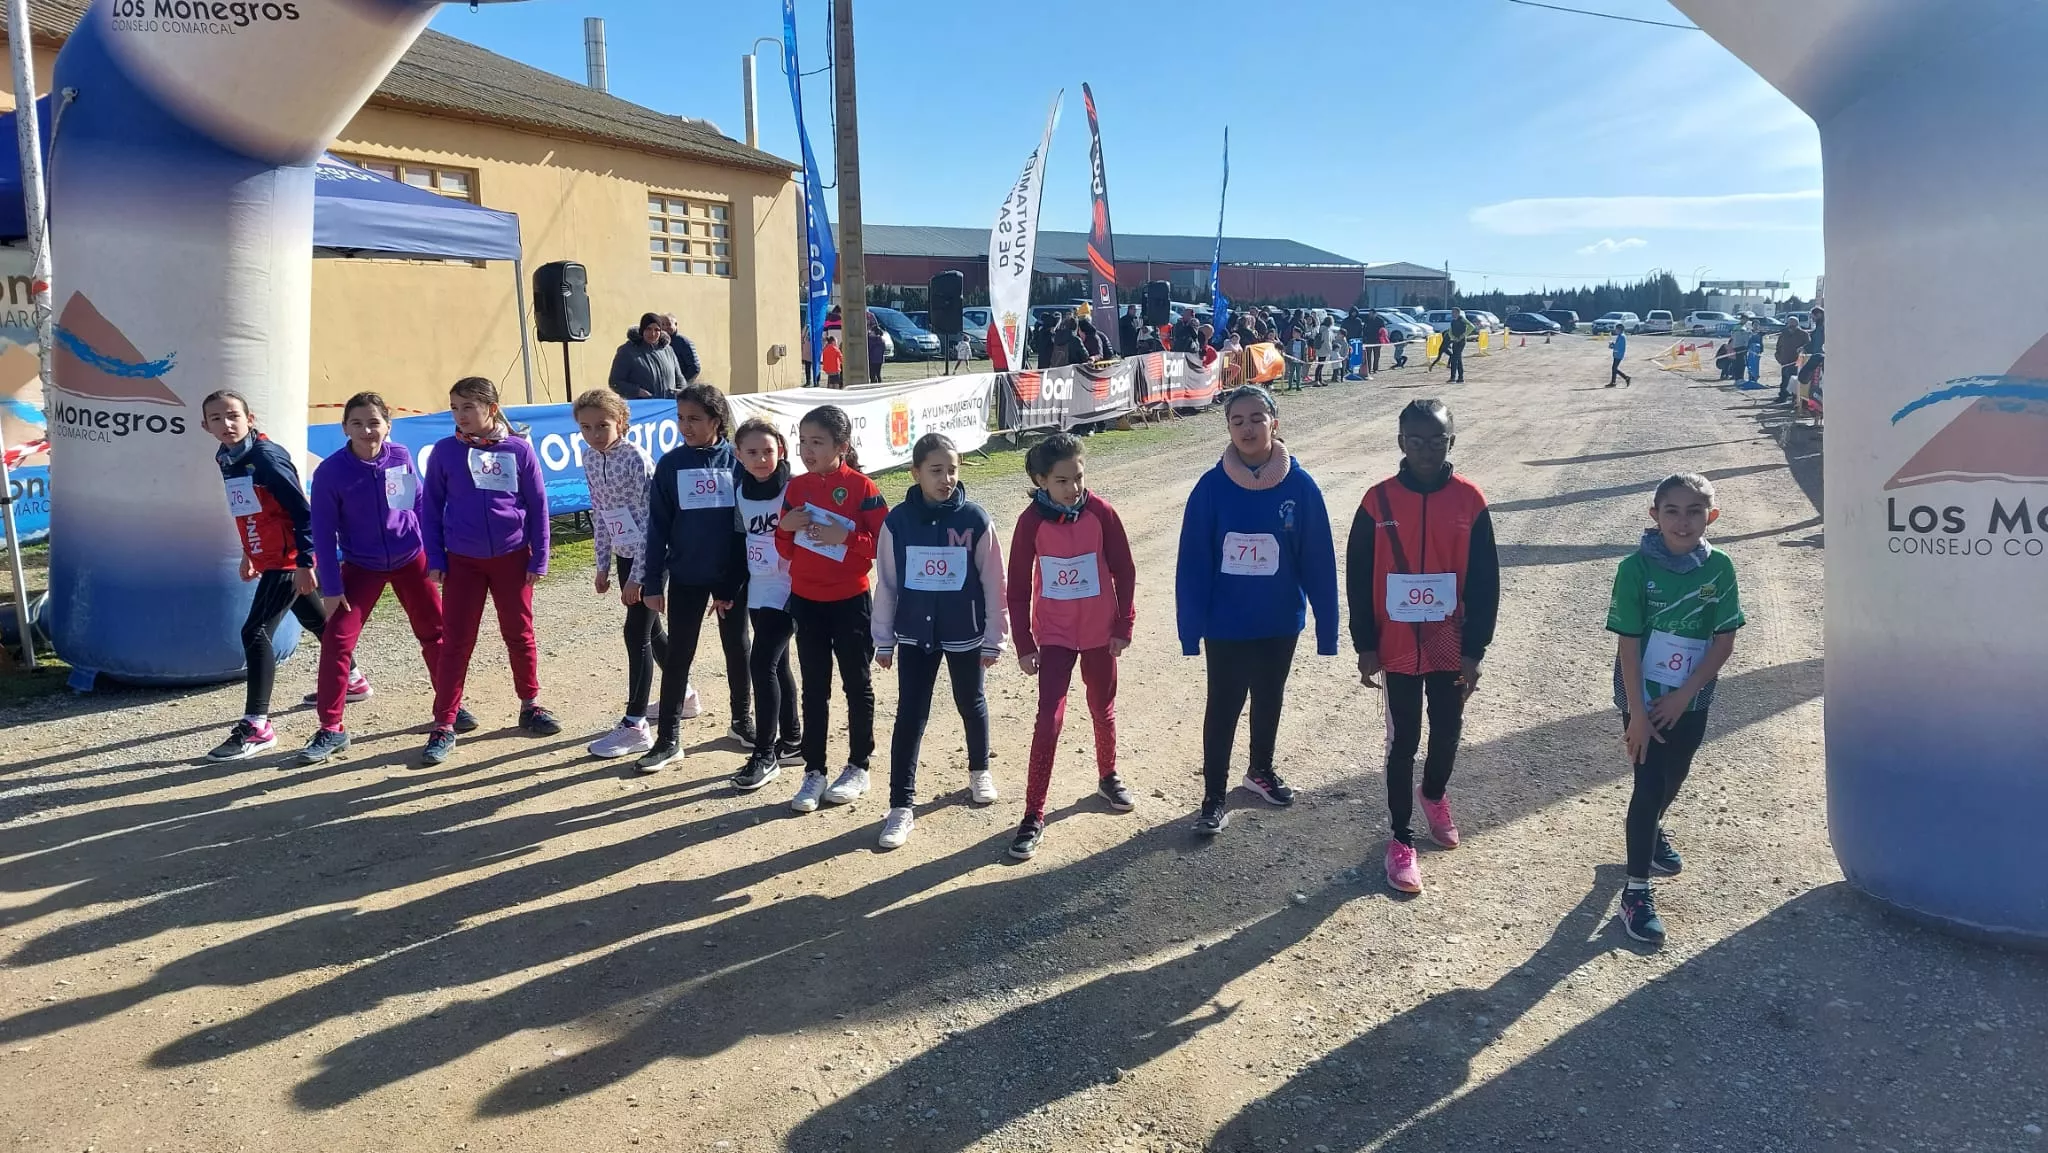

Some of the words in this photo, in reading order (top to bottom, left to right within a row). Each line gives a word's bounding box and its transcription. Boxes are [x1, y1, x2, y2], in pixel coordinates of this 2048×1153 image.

[154, 0, 300, 27] Monegros
[112, 19, 159, 33] CONSEJO
[162, 20, 237, 35] COMARCAL
[54, 400, 186, 437] Monegros
[695, 479, 717, 495] 59
[231, 490, 244, 506] 76
[609, 520, 627, 537] 72
[946, 527, 975, 552] M
[1887, 537, 1993, 557] CONSEJO
[747, 545, 764, 562] 65
[1237, 545, 1258, 561] 71
[925, 559, 948, 576] 69
[1058, 568, 1079, 586] 82
[1408, 587, 1435, 605] 96
[1668, 652, 1693, 674] 81
